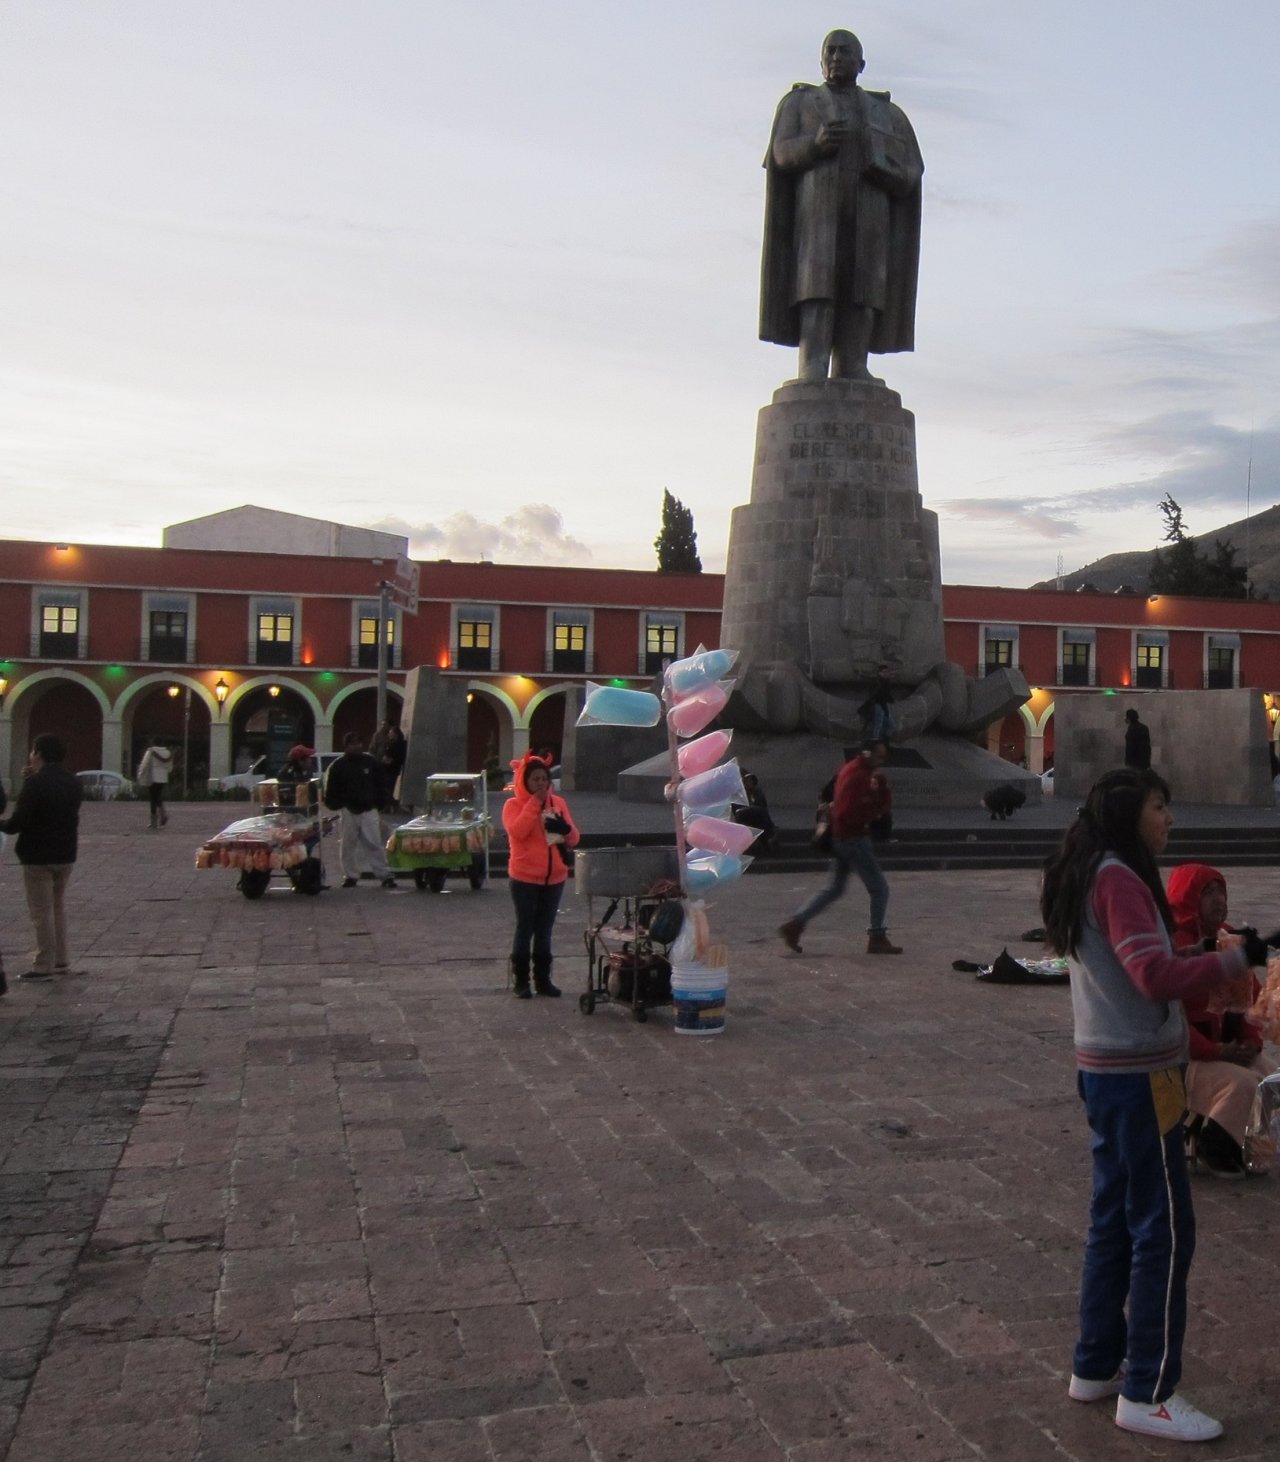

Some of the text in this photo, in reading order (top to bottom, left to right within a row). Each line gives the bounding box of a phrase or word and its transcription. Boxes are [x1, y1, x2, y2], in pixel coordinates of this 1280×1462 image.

[793, 423, 811, 438] EL
[822, 422, 894, 442] RESPETO
[790, 442, 870, 459] DERECHO
